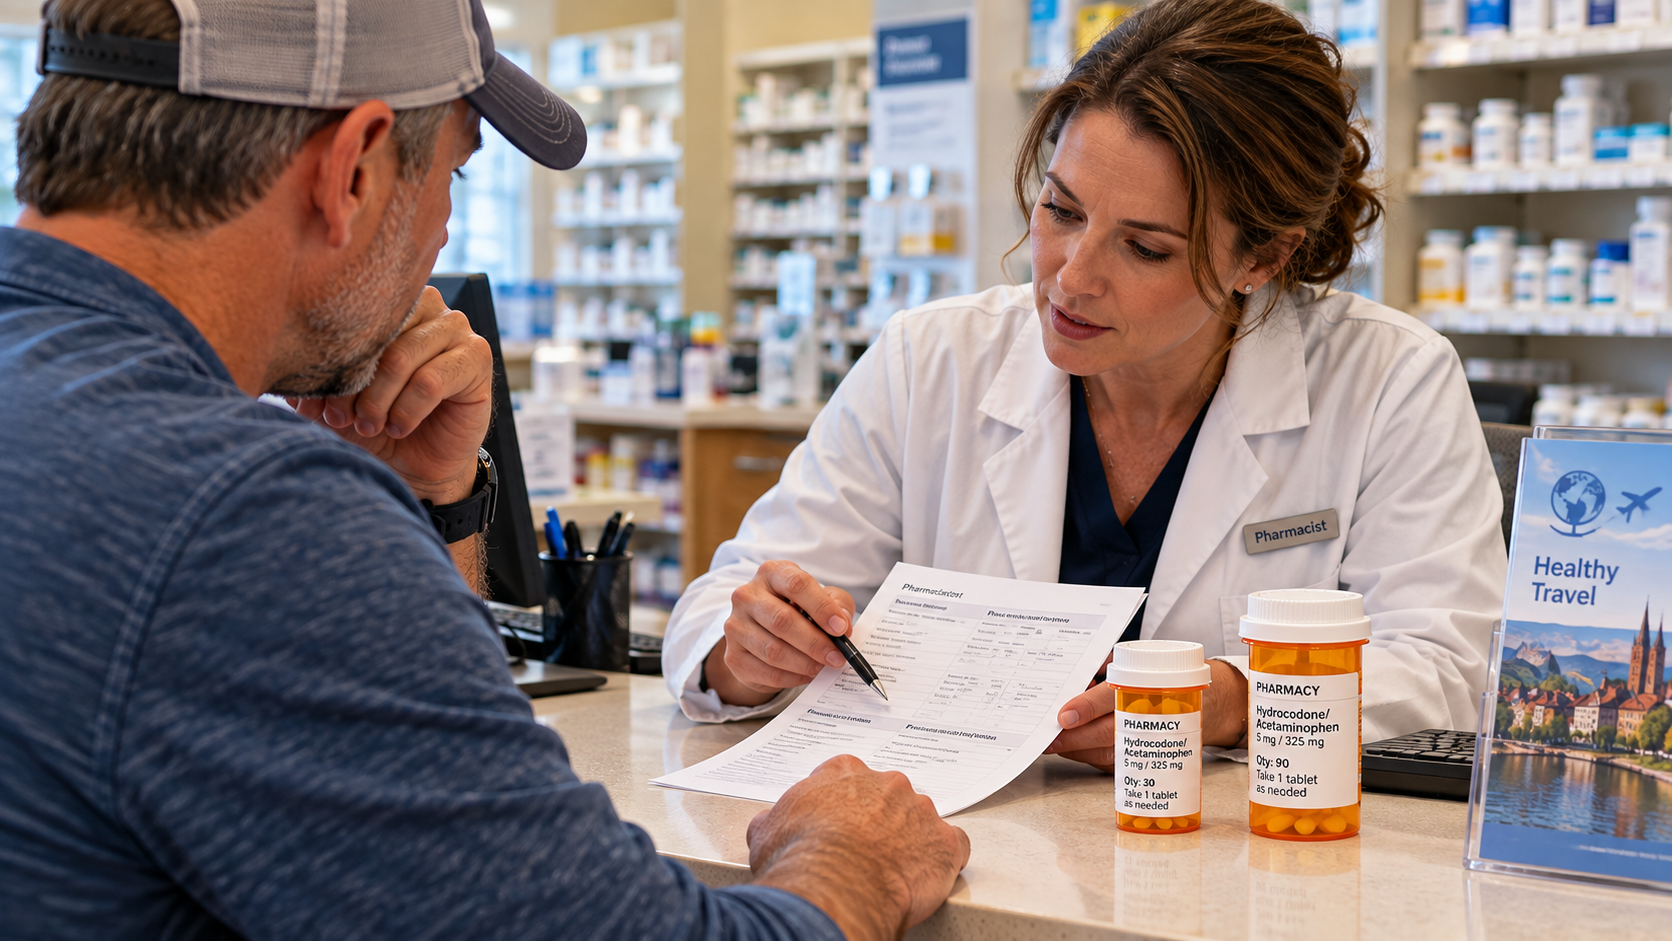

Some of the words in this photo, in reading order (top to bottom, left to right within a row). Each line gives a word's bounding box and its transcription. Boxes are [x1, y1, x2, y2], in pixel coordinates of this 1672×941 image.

[1255, 520, 1327, 543] Pharmacist
[1534, 556, 1620, 586] Healthy
[1531, 582, 1596, 606] Travel
[1256, 681, 1320, 696] PHARMACY
[1256, 705, 1330, 719] Hydrocodone/
[1124, 719, 1180, 731] PHARMACY
[1256, 719, 1339, 735] Acetaminophen
[1124, 737, 1187, 748] Hydrocodone/
[1263, 736, 1276, 747] mg
[1285, 736, 1305, 746] 325
[1308, 738, 1325, 749] mg
[1124, 748, 1193, 760] Acetaminophen
[1130, 760, 1143, 770] mg
[1151, 761, 1167, 770] 325
[1170, 762, 1183, 771] mg
[1275, 758, 1289, 768] 90
[1143, 778, 1155, 787] 30
[1256, 769, 1275, 782] Take
[1278, 773, 1283, 782] 1
[1286, 774, 1318, 785] tablet
[1124, 788, 1142, 799] Take
[1145, 790, 1149, 799] 1
[1152, 791, 1178, 800] tablet
[1256, 784, 1265, 793] as
[1124, 800, 1133, 808] as
[1135, 801, 1169, 810] needed
